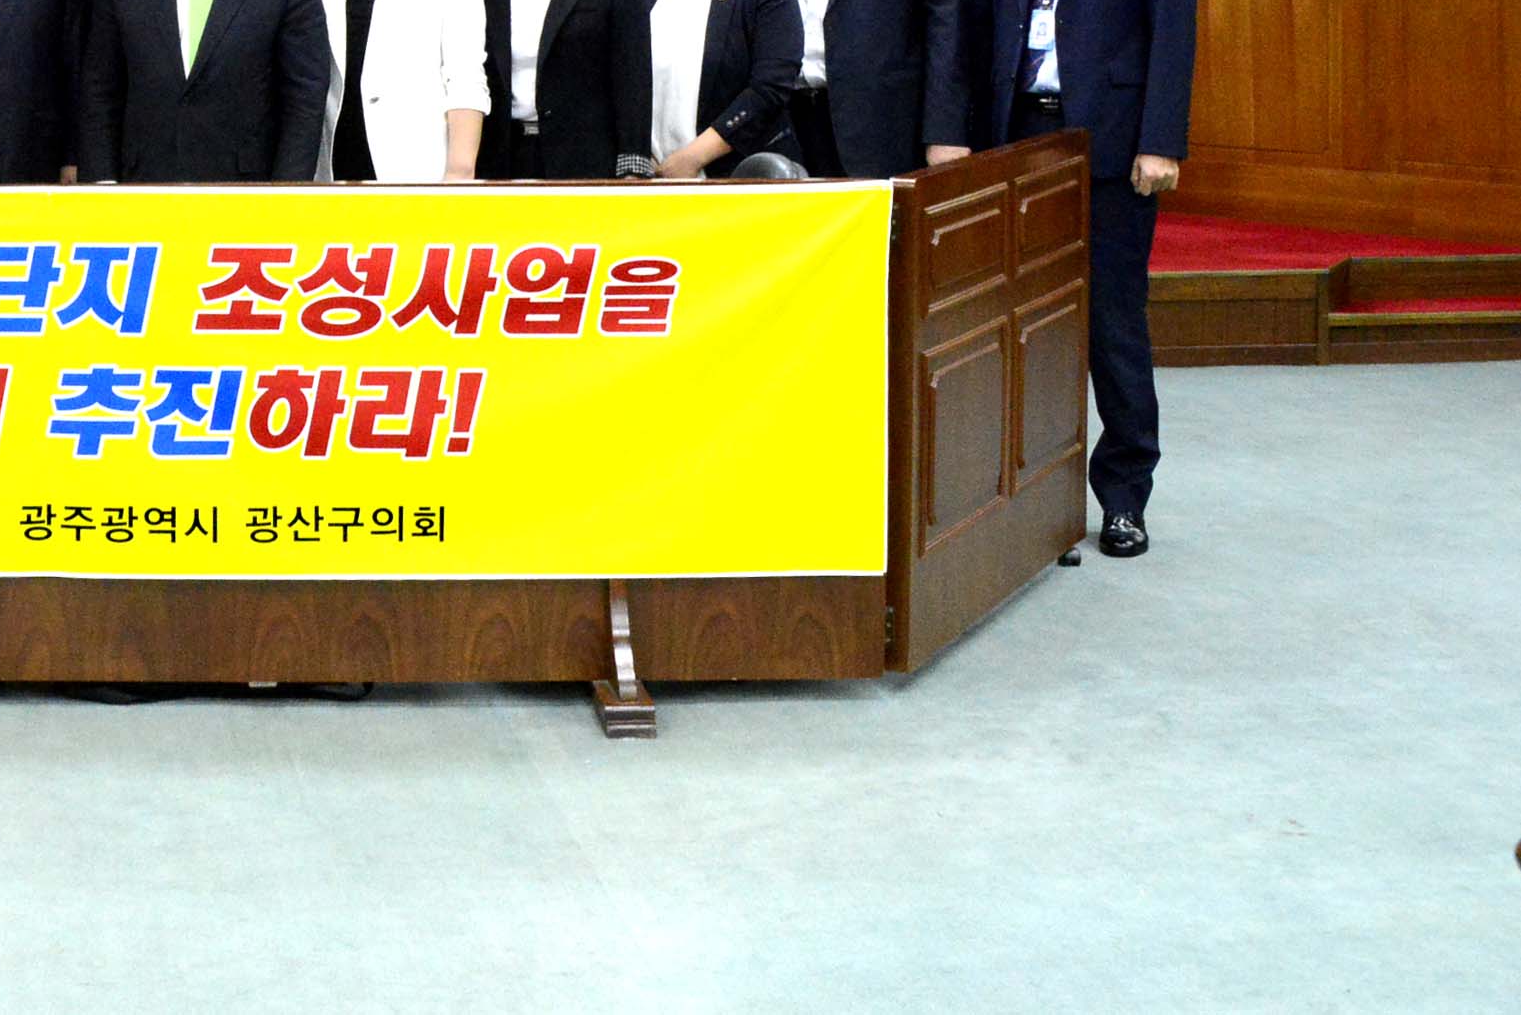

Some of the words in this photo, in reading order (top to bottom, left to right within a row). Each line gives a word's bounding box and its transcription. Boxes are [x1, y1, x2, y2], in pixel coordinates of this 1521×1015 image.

[195, 246, 678, 336] 조성사업을
[50, 367, 483, 457] 추진하라!
[19, 504, 217, 542] 광주광역시
[245, 505, 444, 543] 광산구의회
